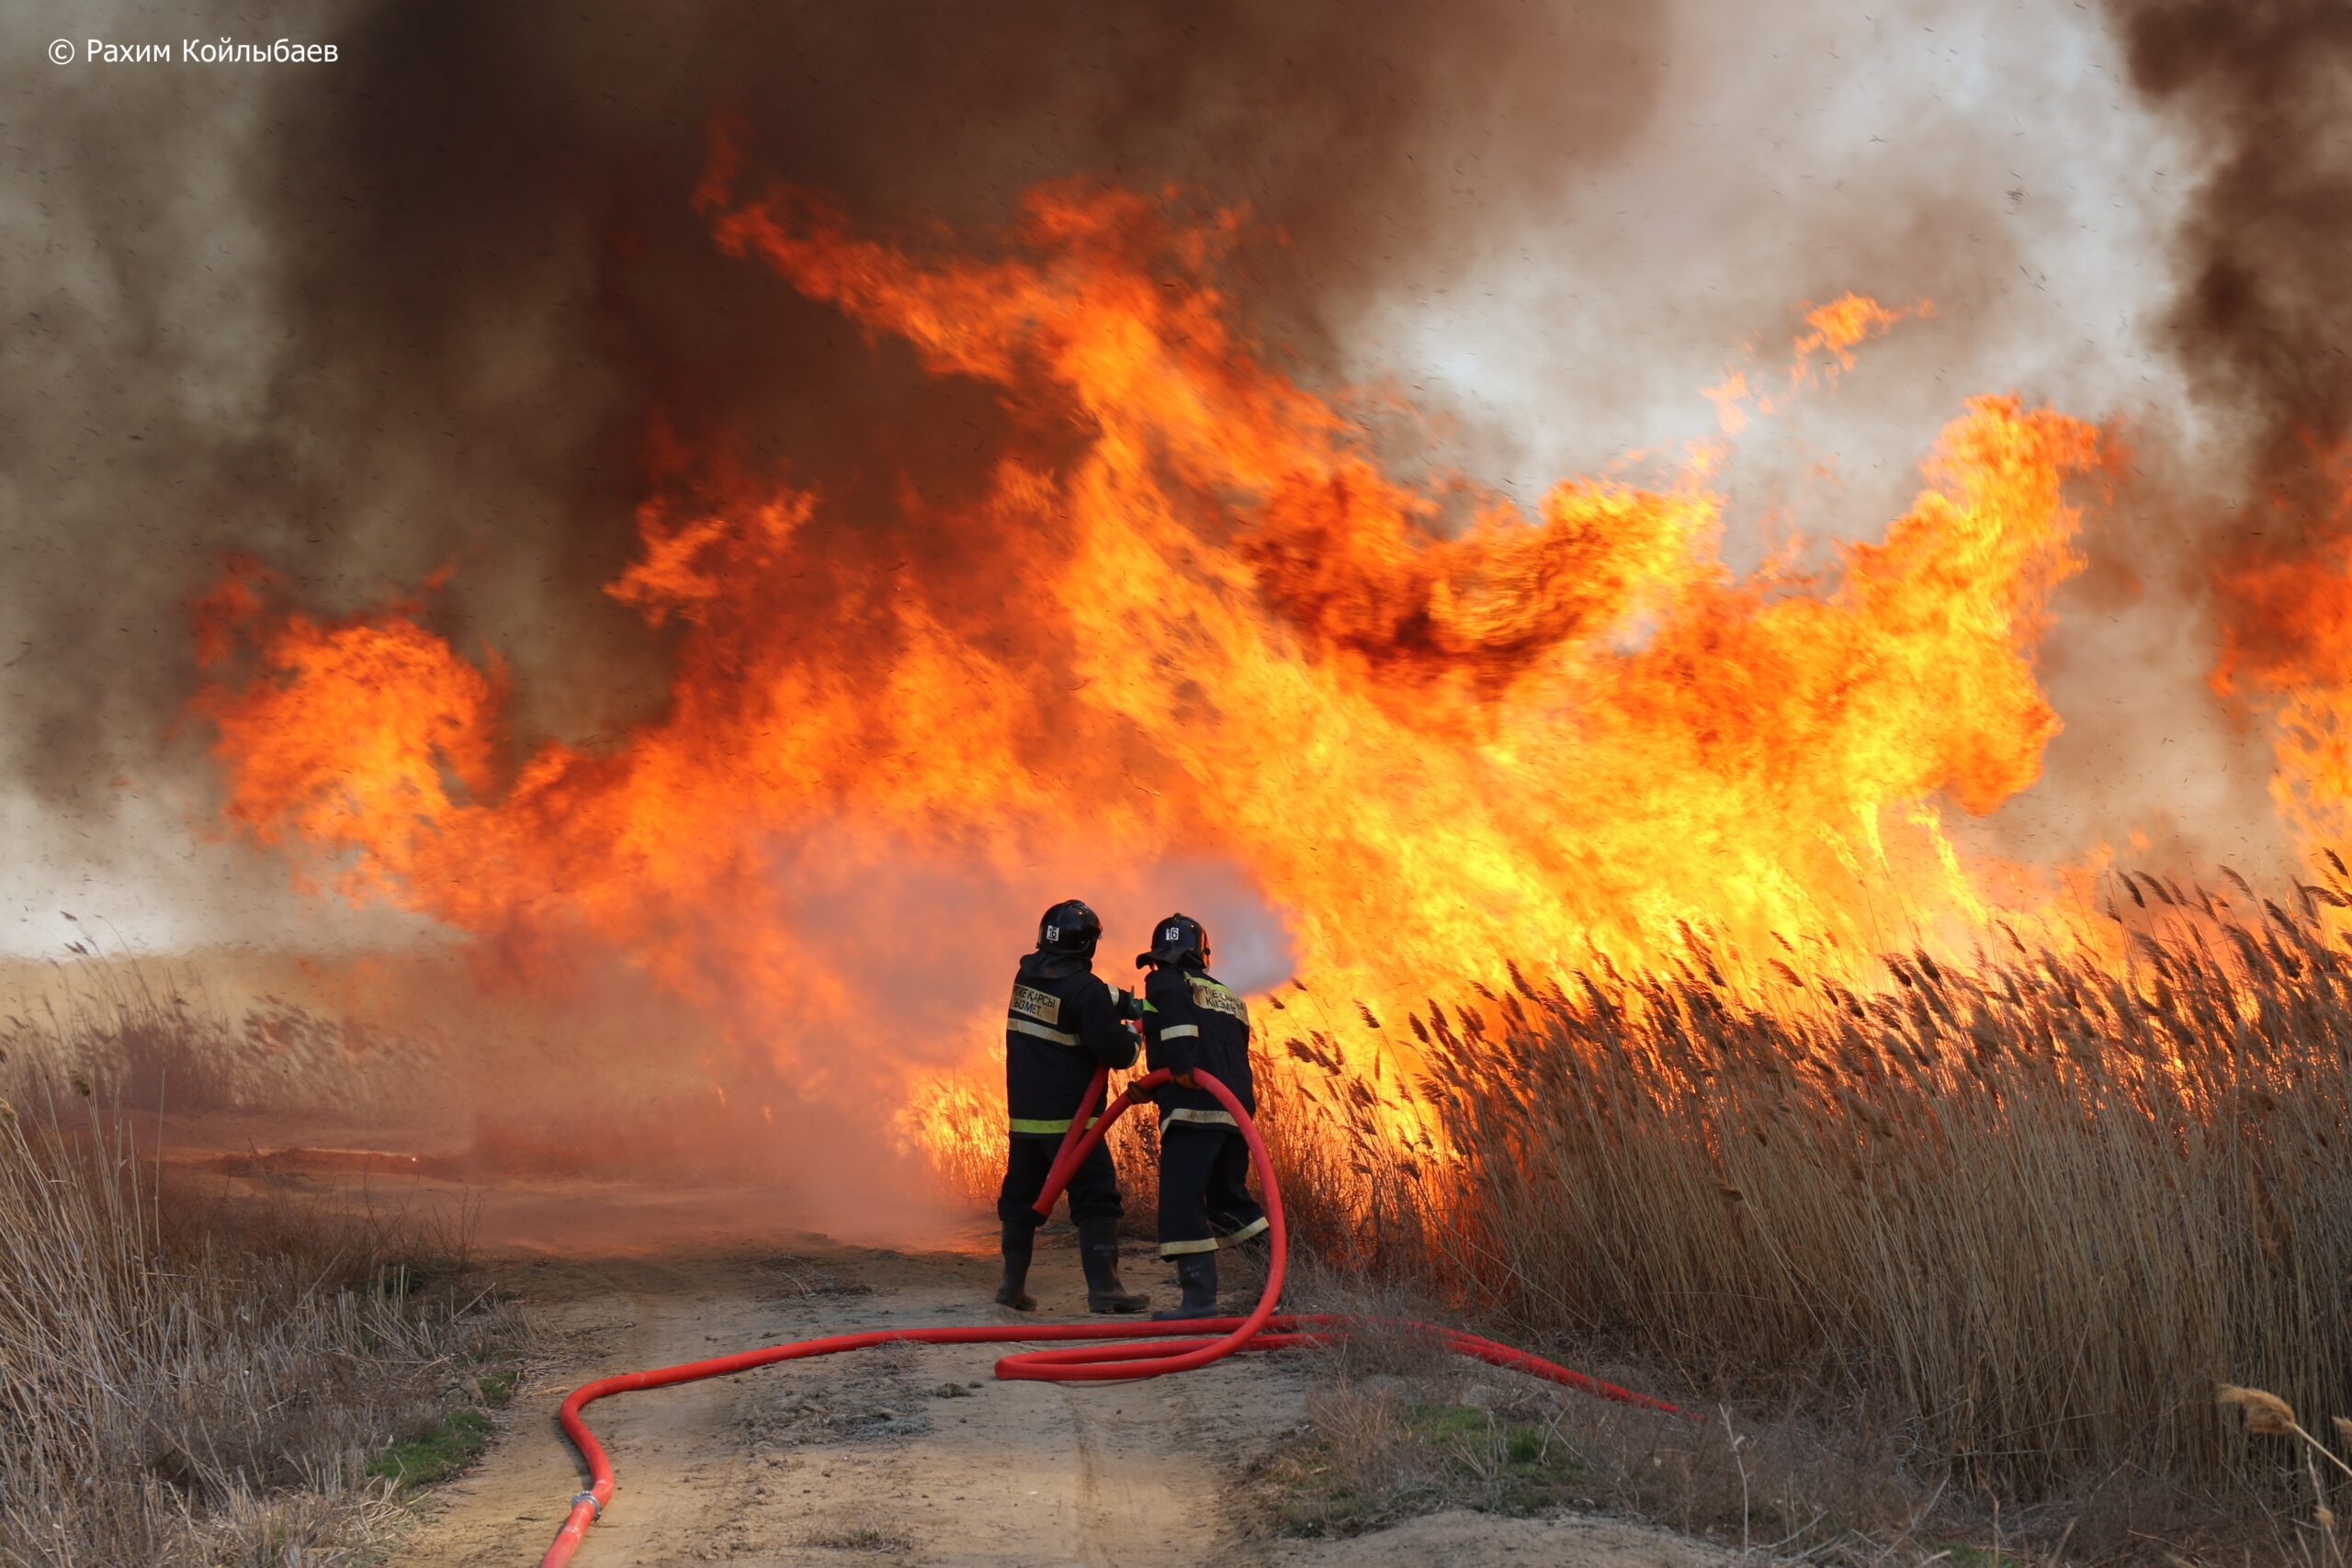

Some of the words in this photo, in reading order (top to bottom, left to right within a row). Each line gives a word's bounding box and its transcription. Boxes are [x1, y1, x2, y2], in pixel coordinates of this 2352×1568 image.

[1047, 926, 1057, 940] 16
[1167, 928, 1178, 940] 16
[1013, 998, 1042, 1015] ЫЗМЕТ
